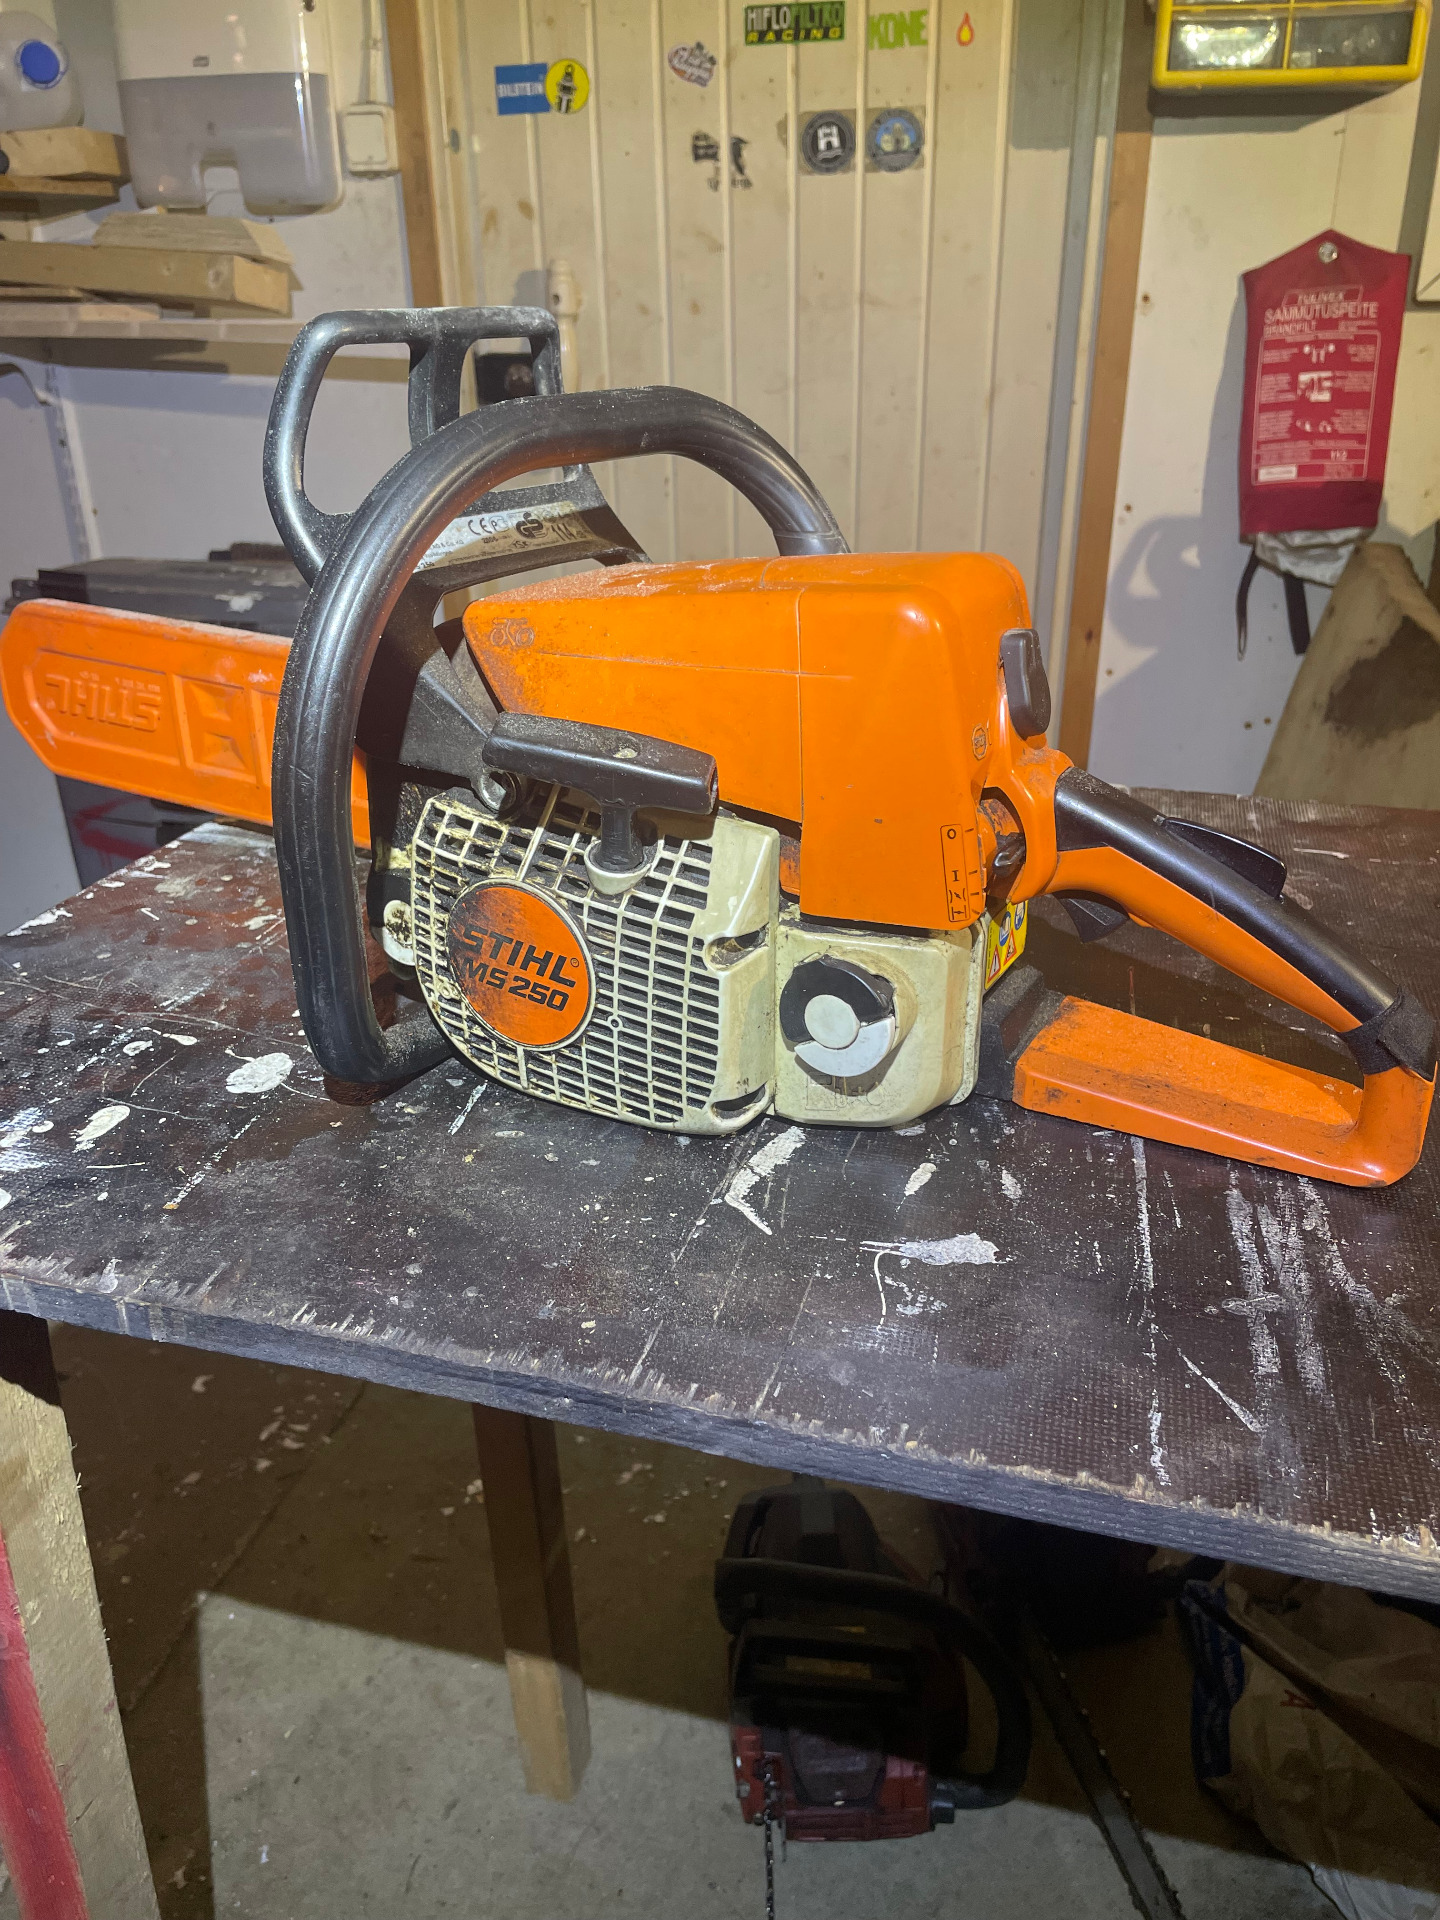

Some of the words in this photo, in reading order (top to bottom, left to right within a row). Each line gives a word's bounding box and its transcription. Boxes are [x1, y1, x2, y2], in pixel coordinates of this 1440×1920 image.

[746, 27, 841, 44] RACING
[868, 9, 928, 50] KONE
[1264, 301, 1378, 325] SAMMUTUSPEITE
[462, 923, 577, 988] STIHL
[463, 956, 509, 989] MS
[507, 976, 570, 1011] 250
